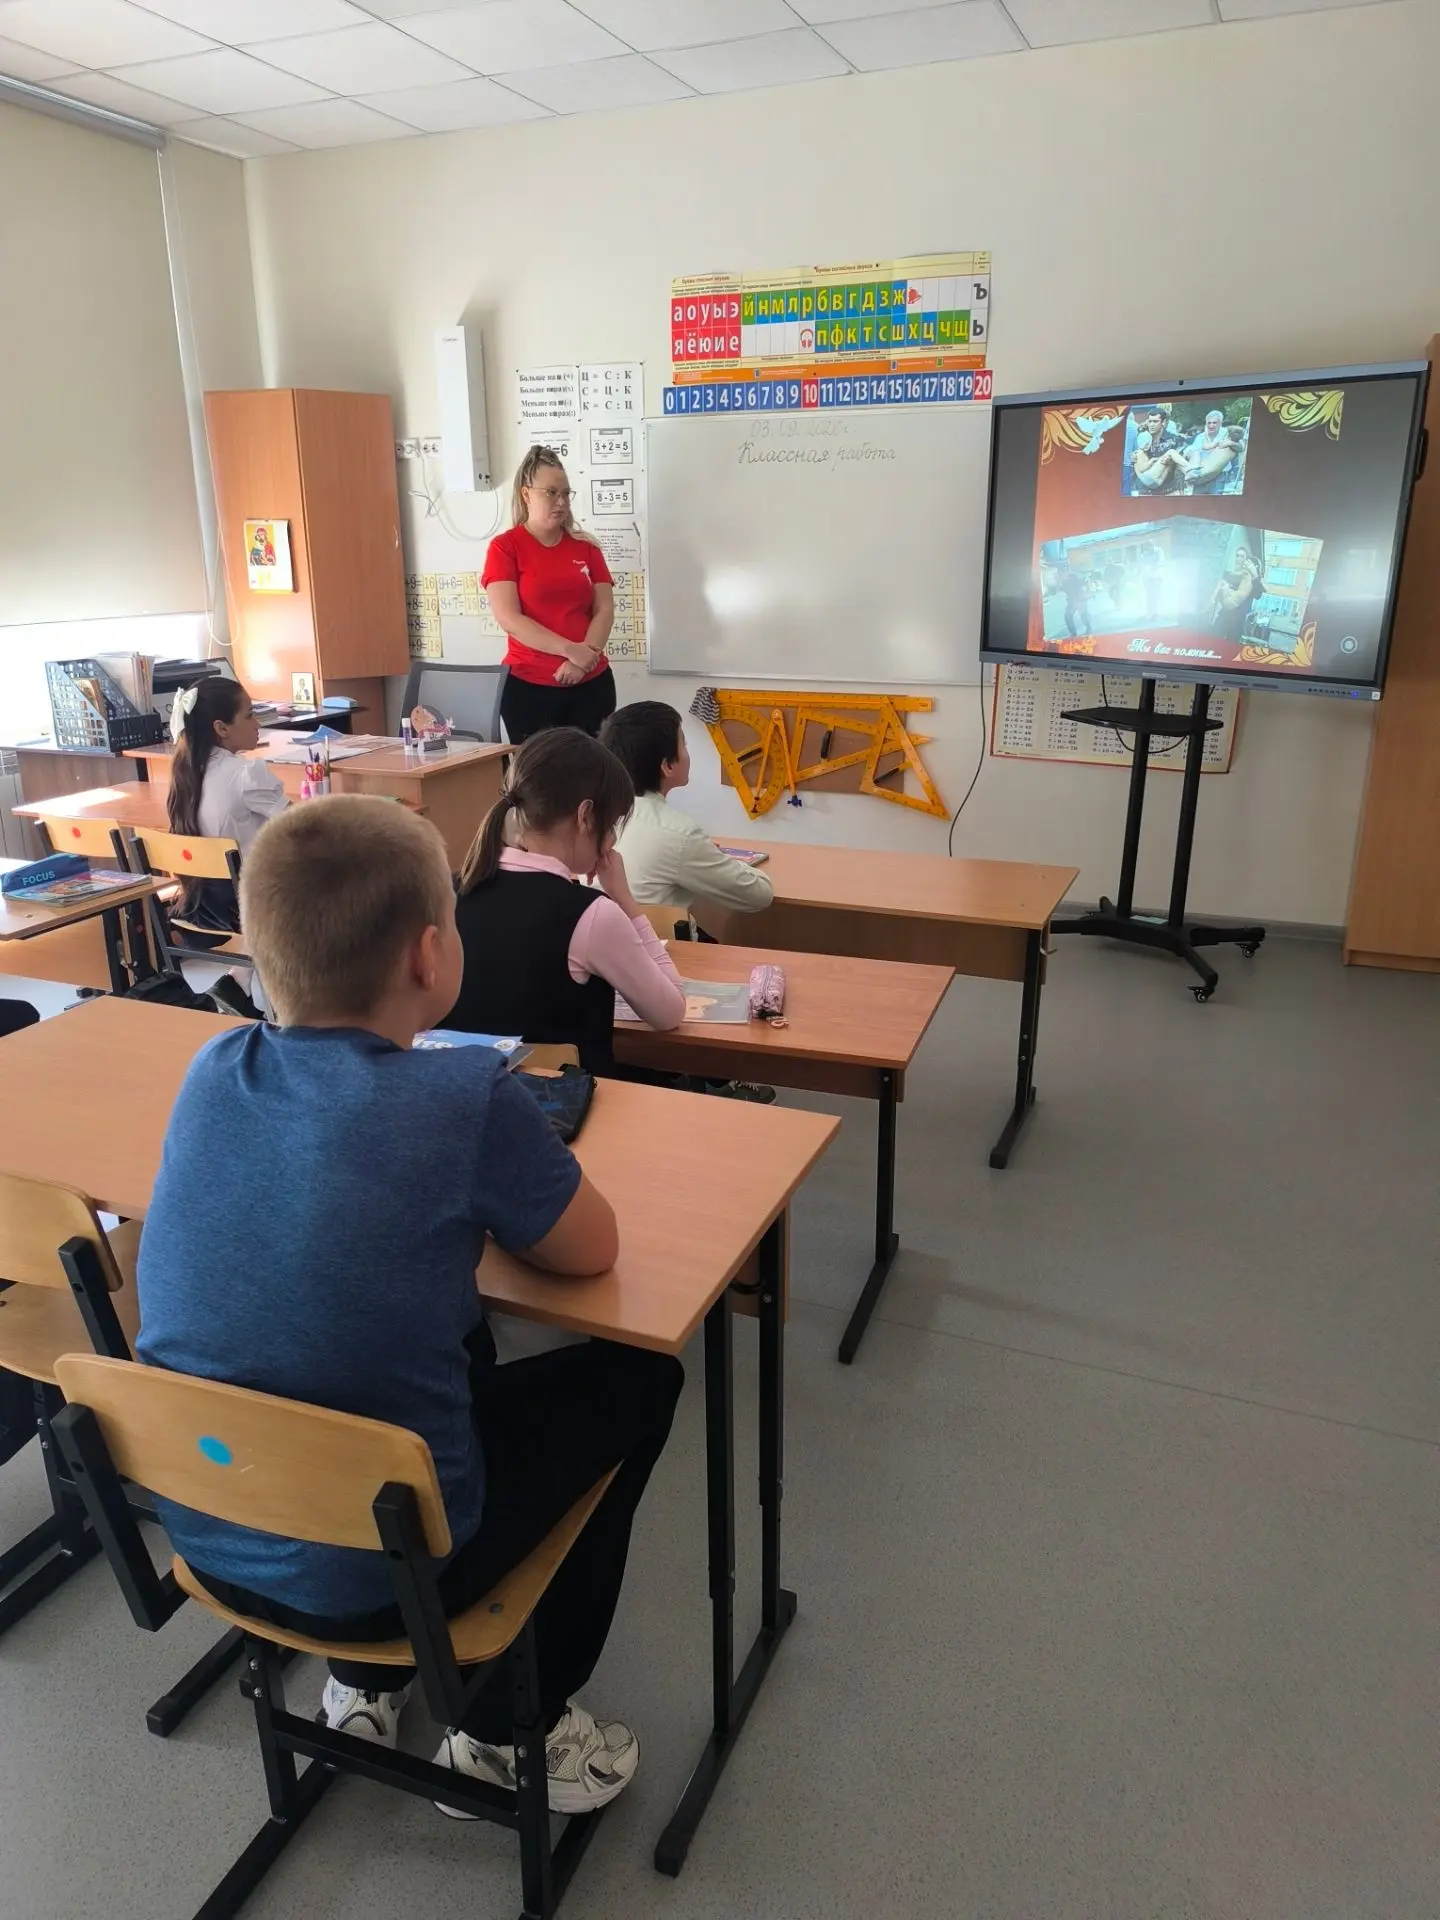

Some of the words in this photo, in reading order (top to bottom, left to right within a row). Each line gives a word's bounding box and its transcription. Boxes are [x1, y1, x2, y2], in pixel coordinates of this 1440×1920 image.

[666, 392, 674, 410] 0
[679, 392, 686, 409] 1
[692, 390, 700, 408] 2
[706, 390, 714, 408] 3
[720, 389, 728, 407] 4
[734, 388, 742, 406] 5
[748, 387, 756, 406] 6
[762, 386, 770, 405] 7
[776, 386, 784, 404] 8
[790, 384, 798, 404] 9
[804, 384, 818, 404] 10
[821, 383, 832, 402] 11
[838, 382, 850, 401] 12
[854, 380, 868, 400] 13
[872, 380, 886, 400] 14
[888, 379, 901, 398] 15
[906, 378, 920, 398] 16
[923, 377, 936, 397] 17
[940, 376, 955, 396] 18
[958, 376, 972, 396] 19
[974, 375, 991, 396] 20
[738, 440, 829, 464] Классная
[831, 442, 897, 472] работа
[22, 870, 56, 886] FOCUS
